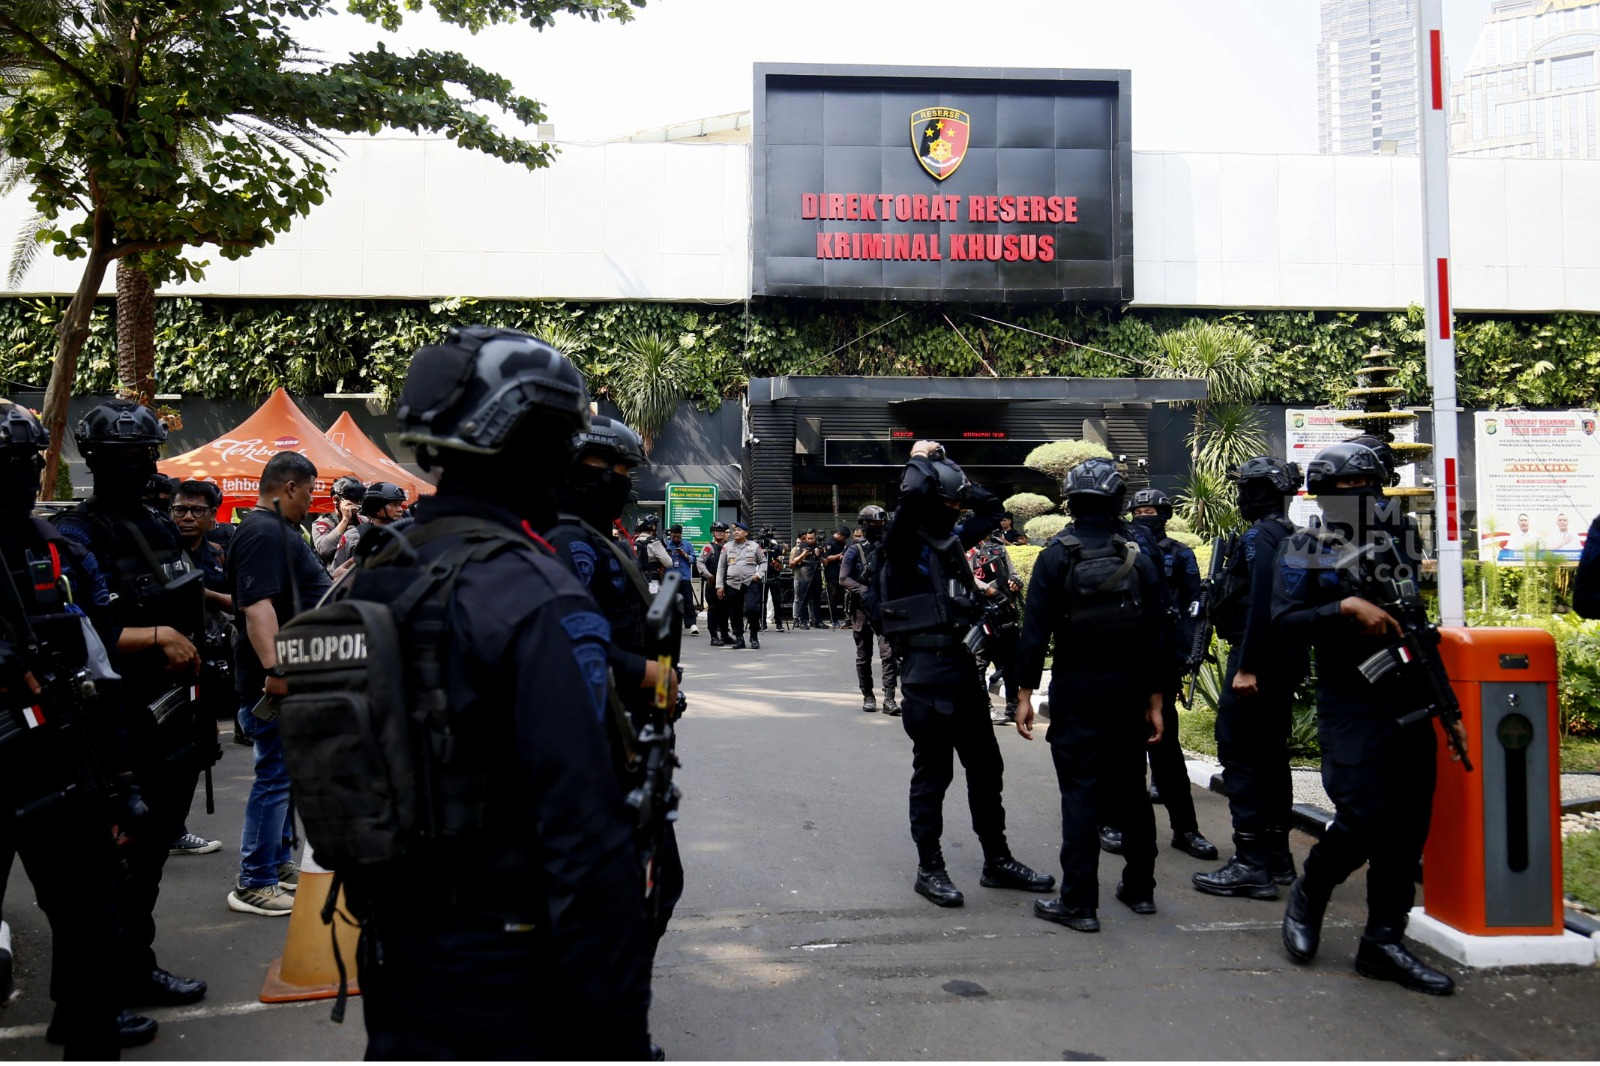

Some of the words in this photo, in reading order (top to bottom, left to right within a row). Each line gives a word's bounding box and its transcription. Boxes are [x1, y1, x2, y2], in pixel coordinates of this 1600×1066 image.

[920, 110, 961, 120] RESERSE
[802, 193, 961, 223] DIREKTORAT
[968, 195, 1078, 223] RESERSE
[816, 232, 943, 262] KRIMINAL
[950, 233, 1055, 263] KHUSUS
[1504, 419, 1537, 427] DIREKTORAT
[1511, 464, 1541, 472] ASTA
[1544, 464, 1571, 472] CITA
